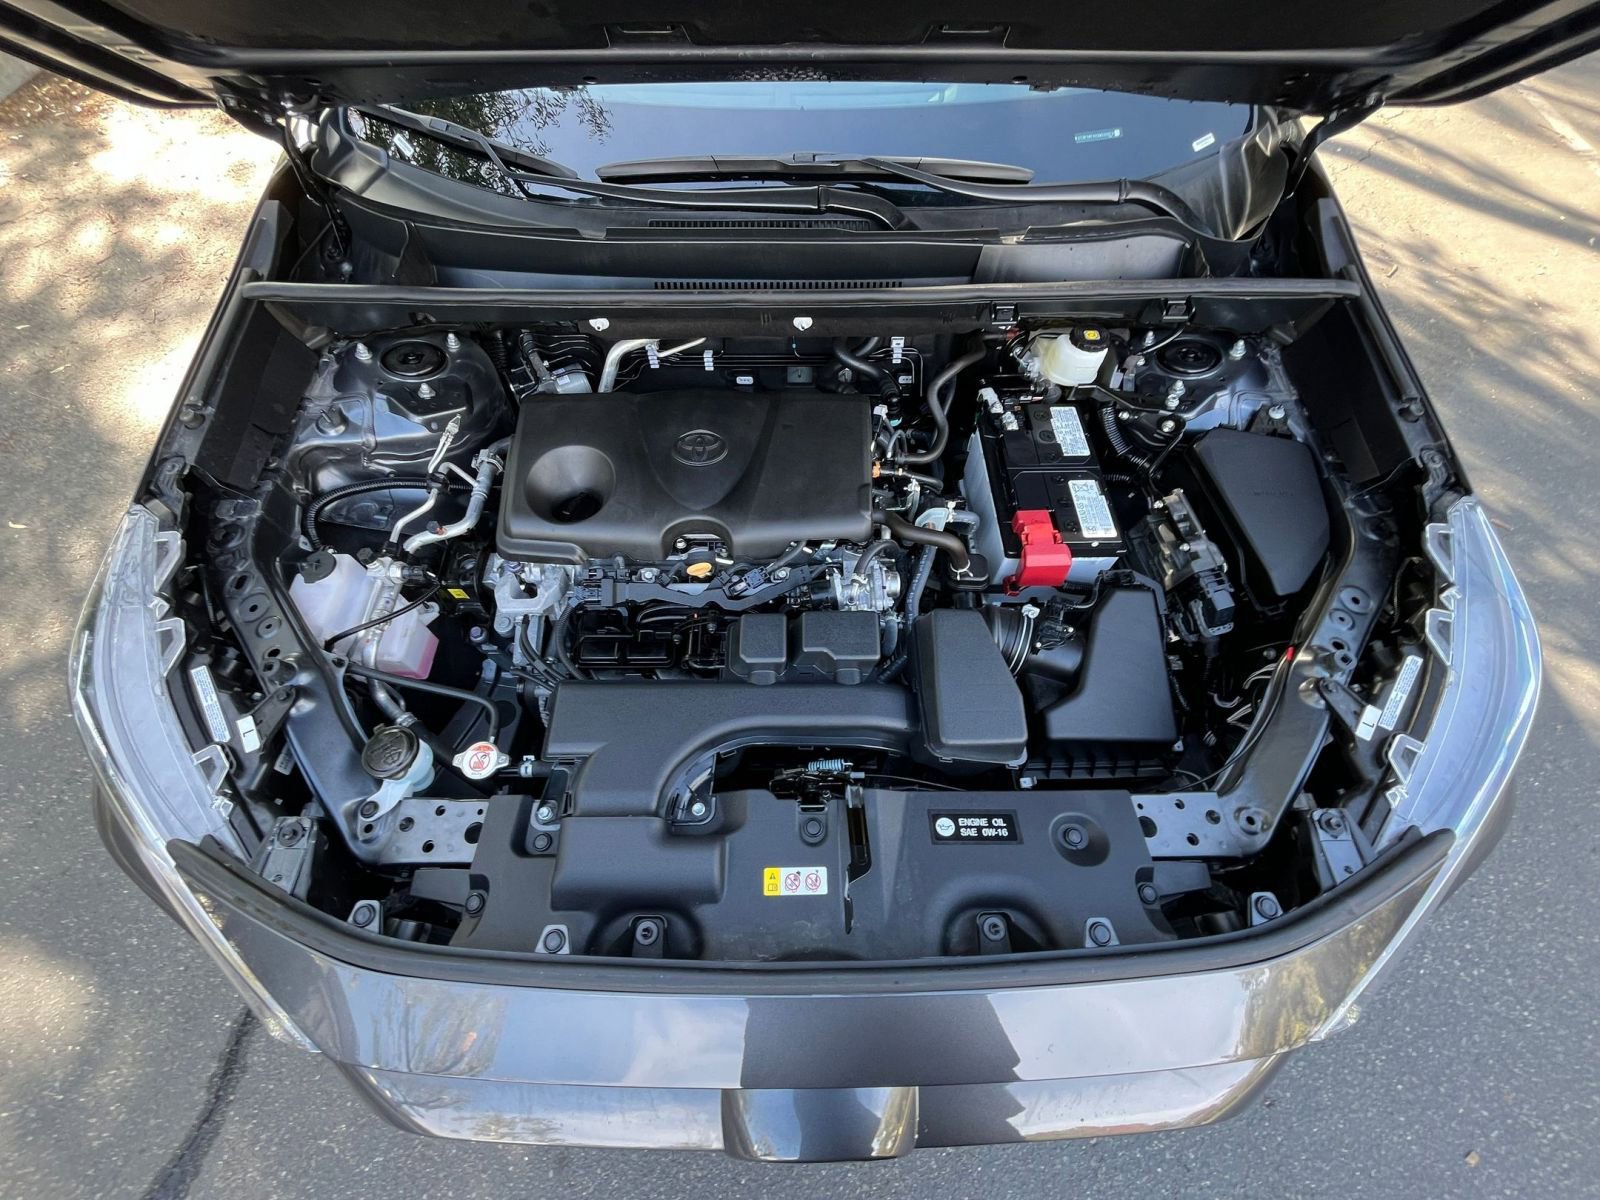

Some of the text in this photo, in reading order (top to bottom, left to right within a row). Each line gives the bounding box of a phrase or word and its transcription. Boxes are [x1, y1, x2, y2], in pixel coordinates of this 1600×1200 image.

[958, 818, 1006, 826] ENGINE OIL
[960, 828, 1008, 836] SAE 0W-16
